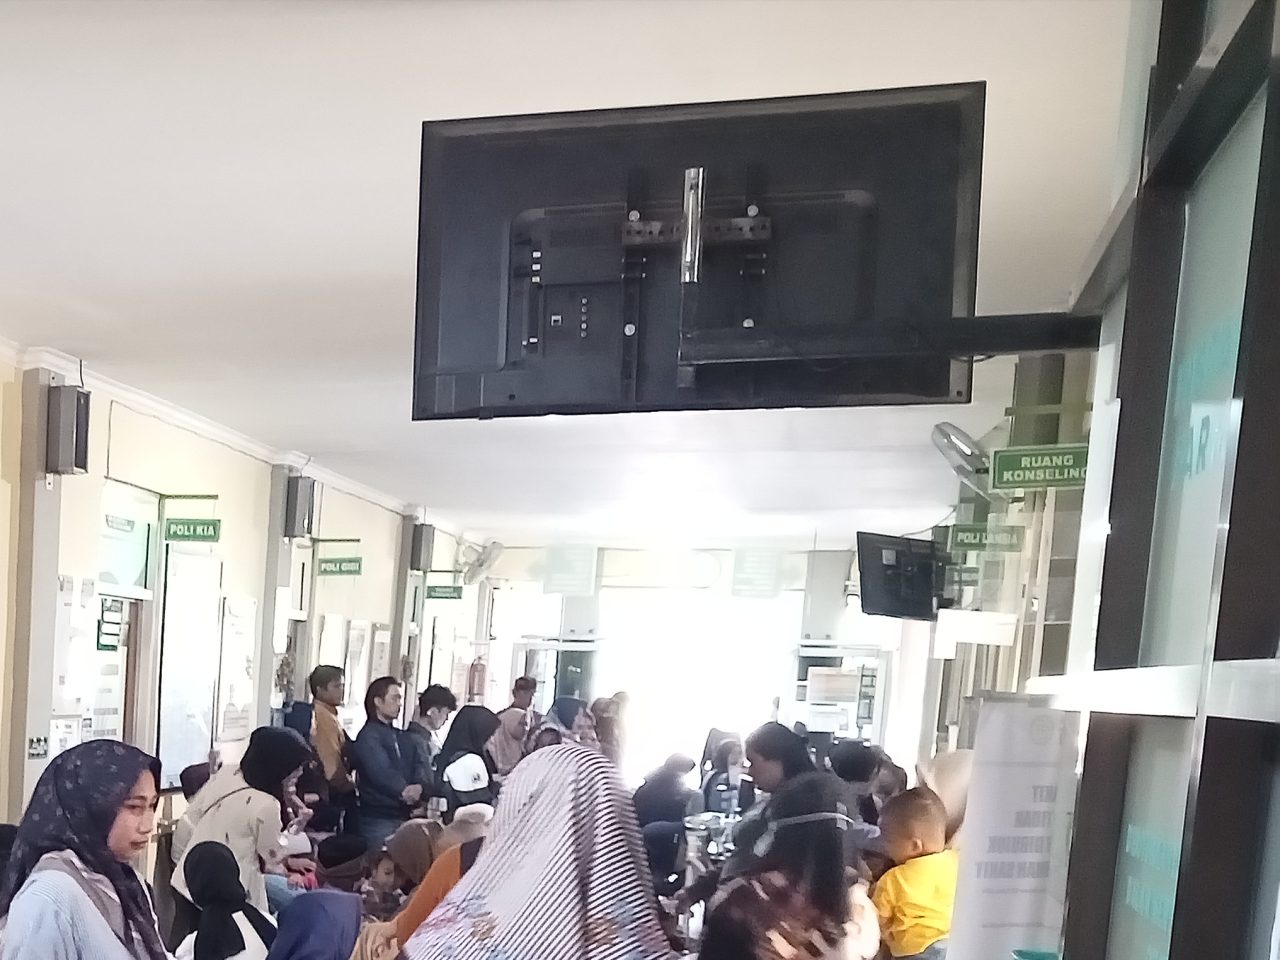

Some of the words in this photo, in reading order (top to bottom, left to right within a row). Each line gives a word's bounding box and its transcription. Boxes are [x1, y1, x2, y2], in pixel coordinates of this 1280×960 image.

[1021, 455, 1074, 468] RUANG
[170, 523, 193, 536] POLI
[196, 524, 215, 536] KIA
[957, 532, 981, 543] POLI
[321, 562, 339, 572] POLI
